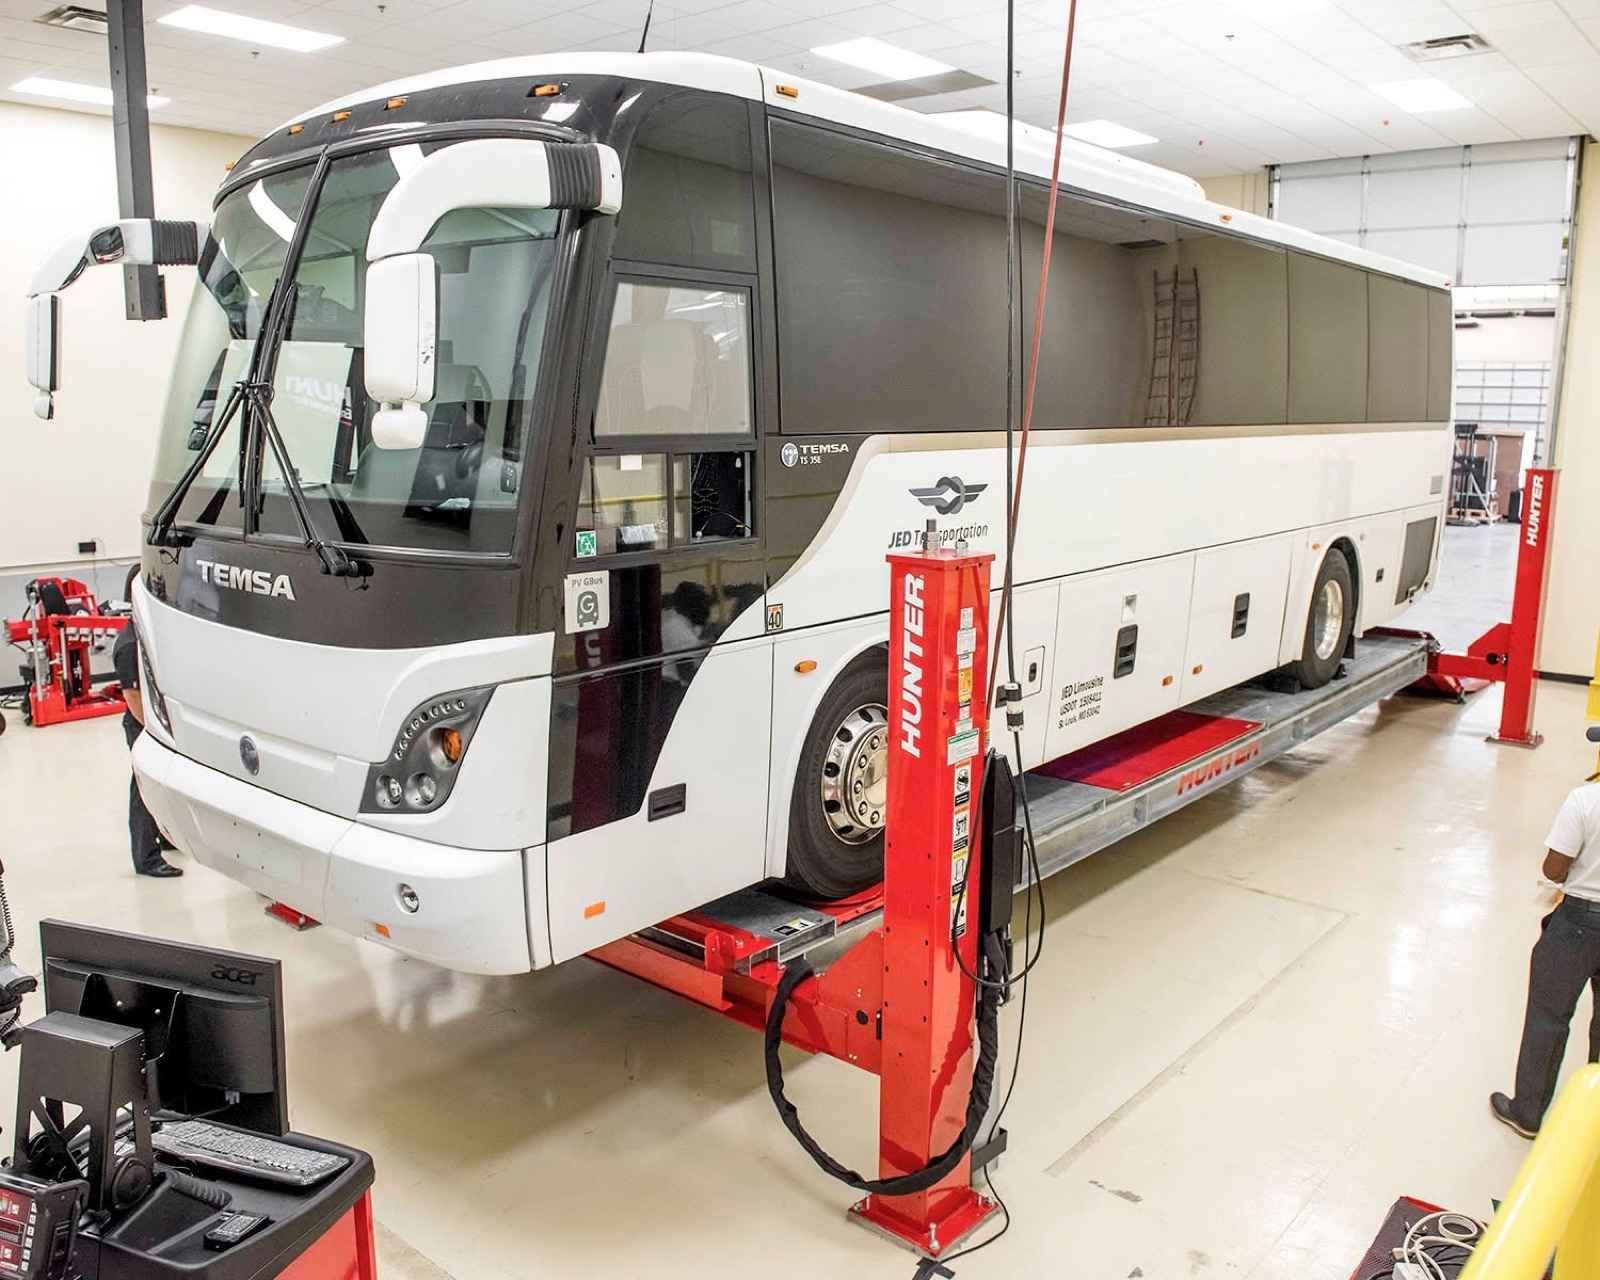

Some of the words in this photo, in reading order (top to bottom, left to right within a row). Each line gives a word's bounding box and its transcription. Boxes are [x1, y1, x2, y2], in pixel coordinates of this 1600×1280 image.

[799, 443, 850, 455] TEMSA
[1526, 475, 1544, 547] HUNTER
[888, 530, 912, 549] JED
[914, 522, 988, 546] Trsportation
[195, 559, 297, 601] TEMSA
[571, 579, 582, 588] PV
[584, 577, 603, 587] GBus
[768, 611, 782, 628] 40
[901, 573, 925, 758] HUNTER
[1178, 740, 1261, 796] HUNTER
[211, 964, 264, 986] acer
